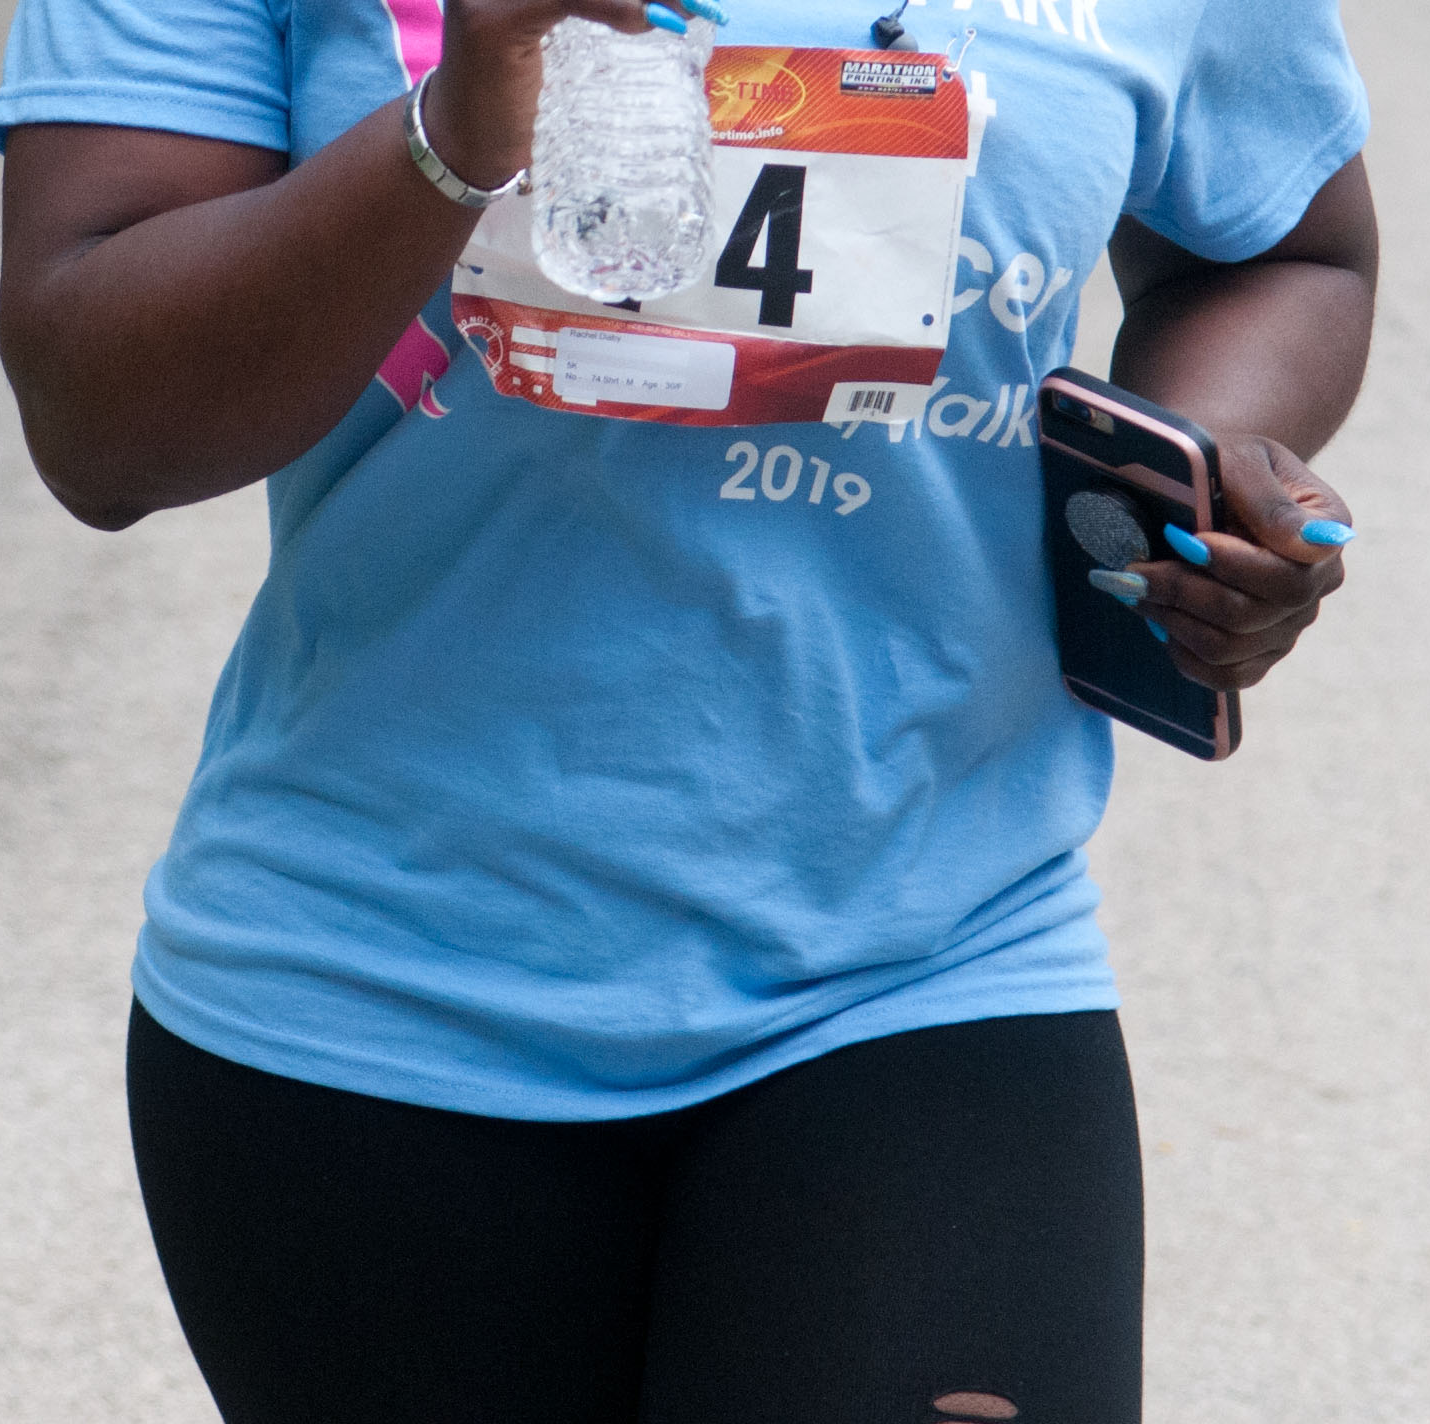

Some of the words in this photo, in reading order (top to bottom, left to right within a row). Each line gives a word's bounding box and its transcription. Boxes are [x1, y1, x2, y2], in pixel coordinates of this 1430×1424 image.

[843, 61, 936, 76] MARATHON
[708, 125, 783, 141] cetime.info
[951, 236, 1074, 333] cer
[719, 440, 872, 516] 2019
